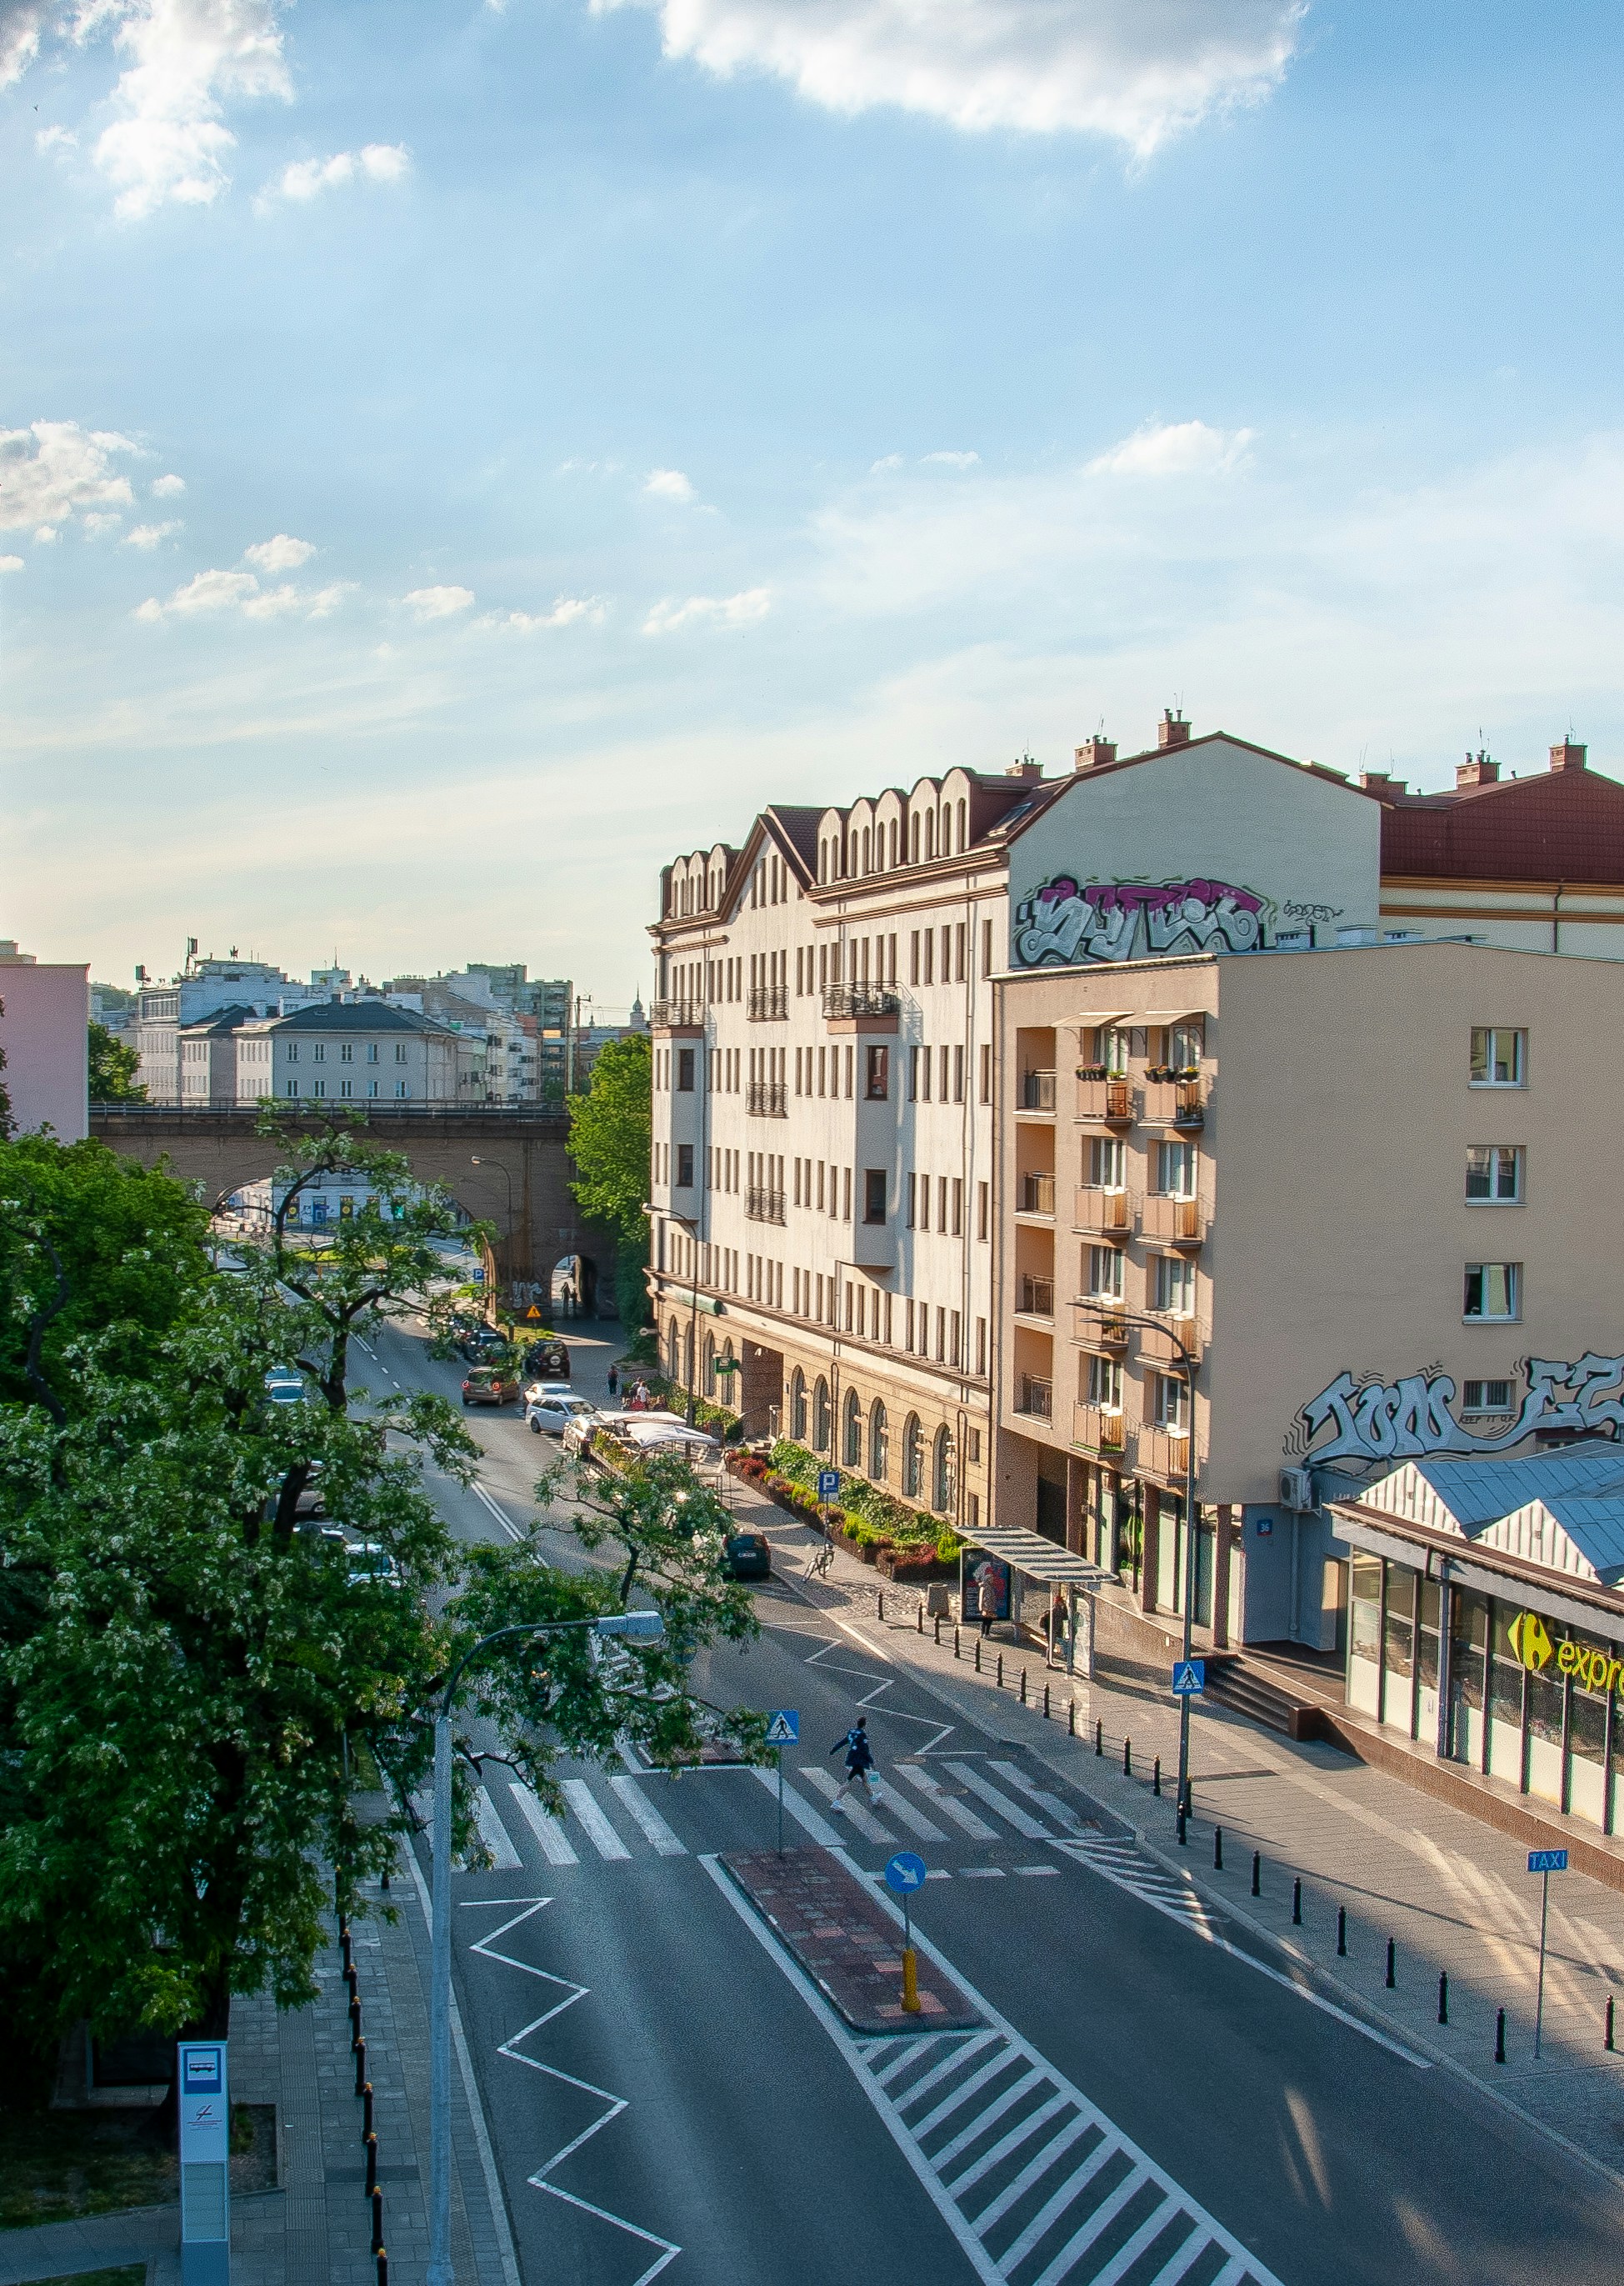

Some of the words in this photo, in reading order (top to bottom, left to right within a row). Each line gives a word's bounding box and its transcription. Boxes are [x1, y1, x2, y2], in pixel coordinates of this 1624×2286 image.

[475, 1269, 483, 1278] P
[1458, 1413, 1482, 1424] KEEP
[823, 1474, 835, 1490] P
[1260, 1523, 1270, 1533] 36
[1529, 1852, 1565, 1869] TAXI
